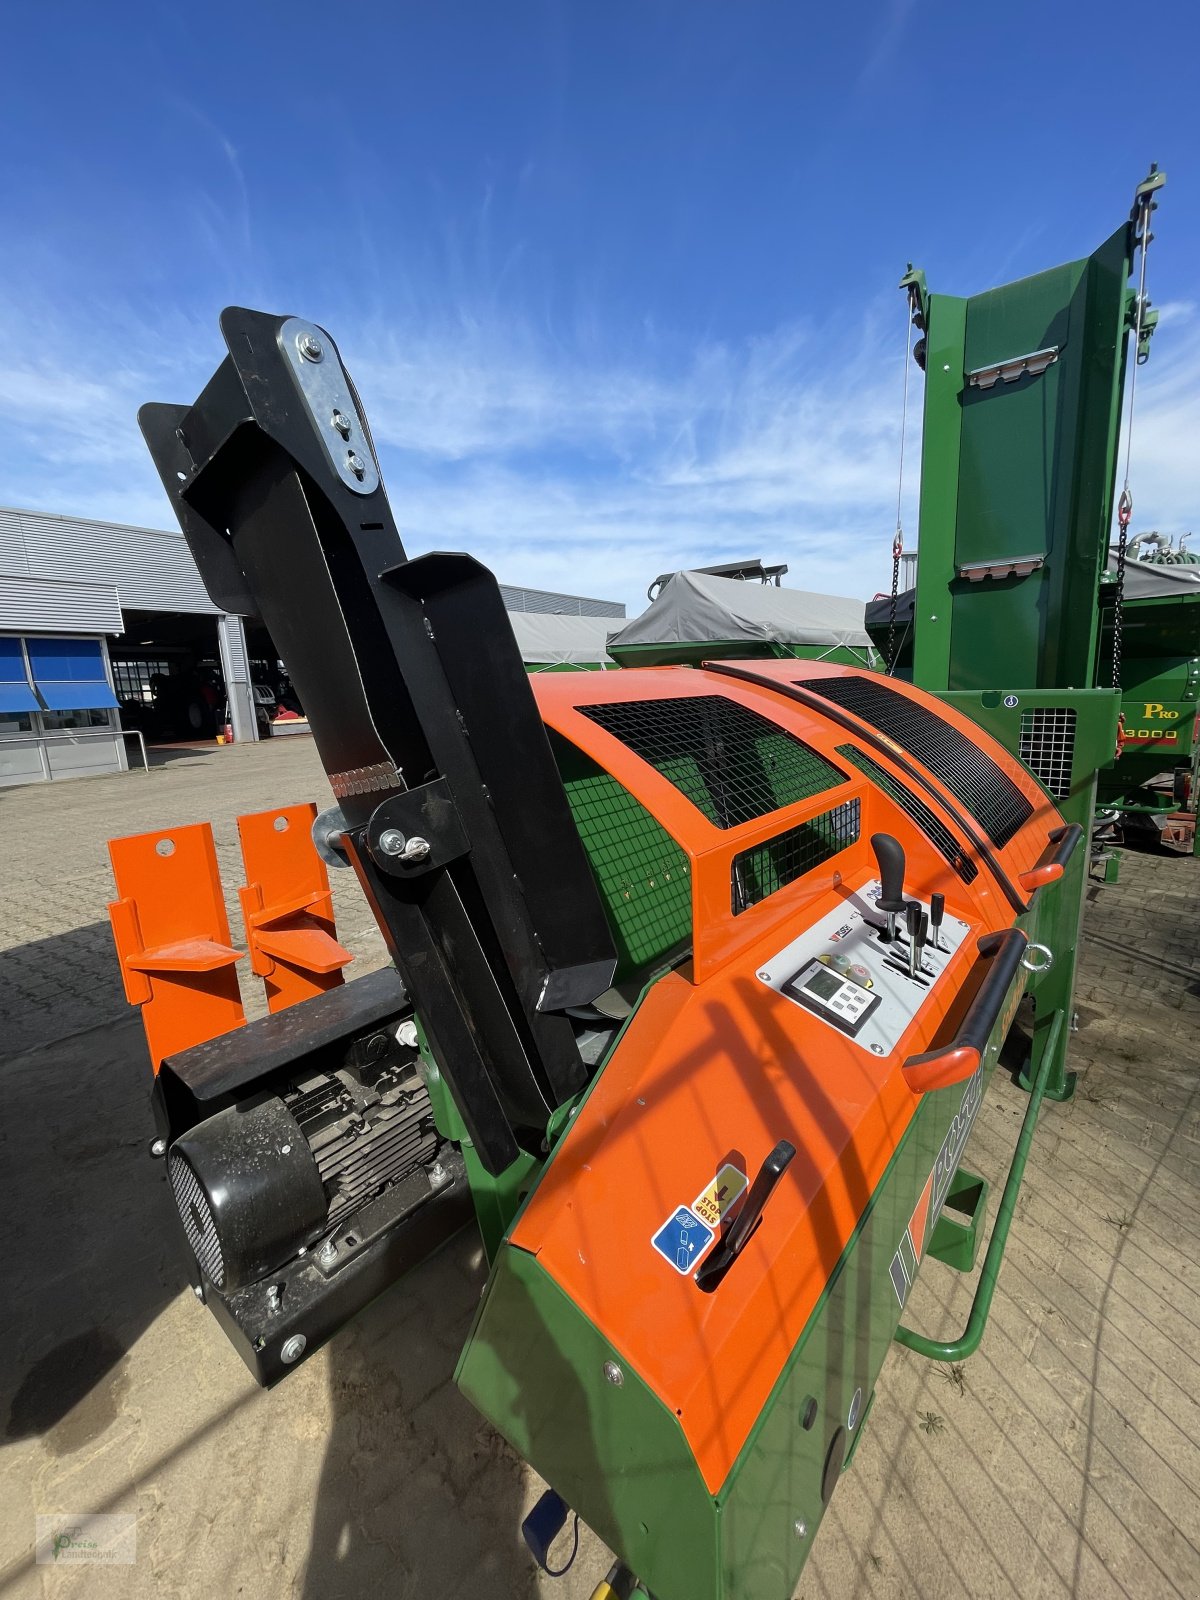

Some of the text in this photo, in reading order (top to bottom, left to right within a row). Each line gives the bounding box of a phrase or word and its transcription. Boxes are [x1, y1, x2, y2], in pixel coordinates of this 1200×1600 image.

[1125, 729, 1177, 739] 3000
[695, 1205, 716, 1224] STOP
[701, 1197, 721, 1215] STOP
